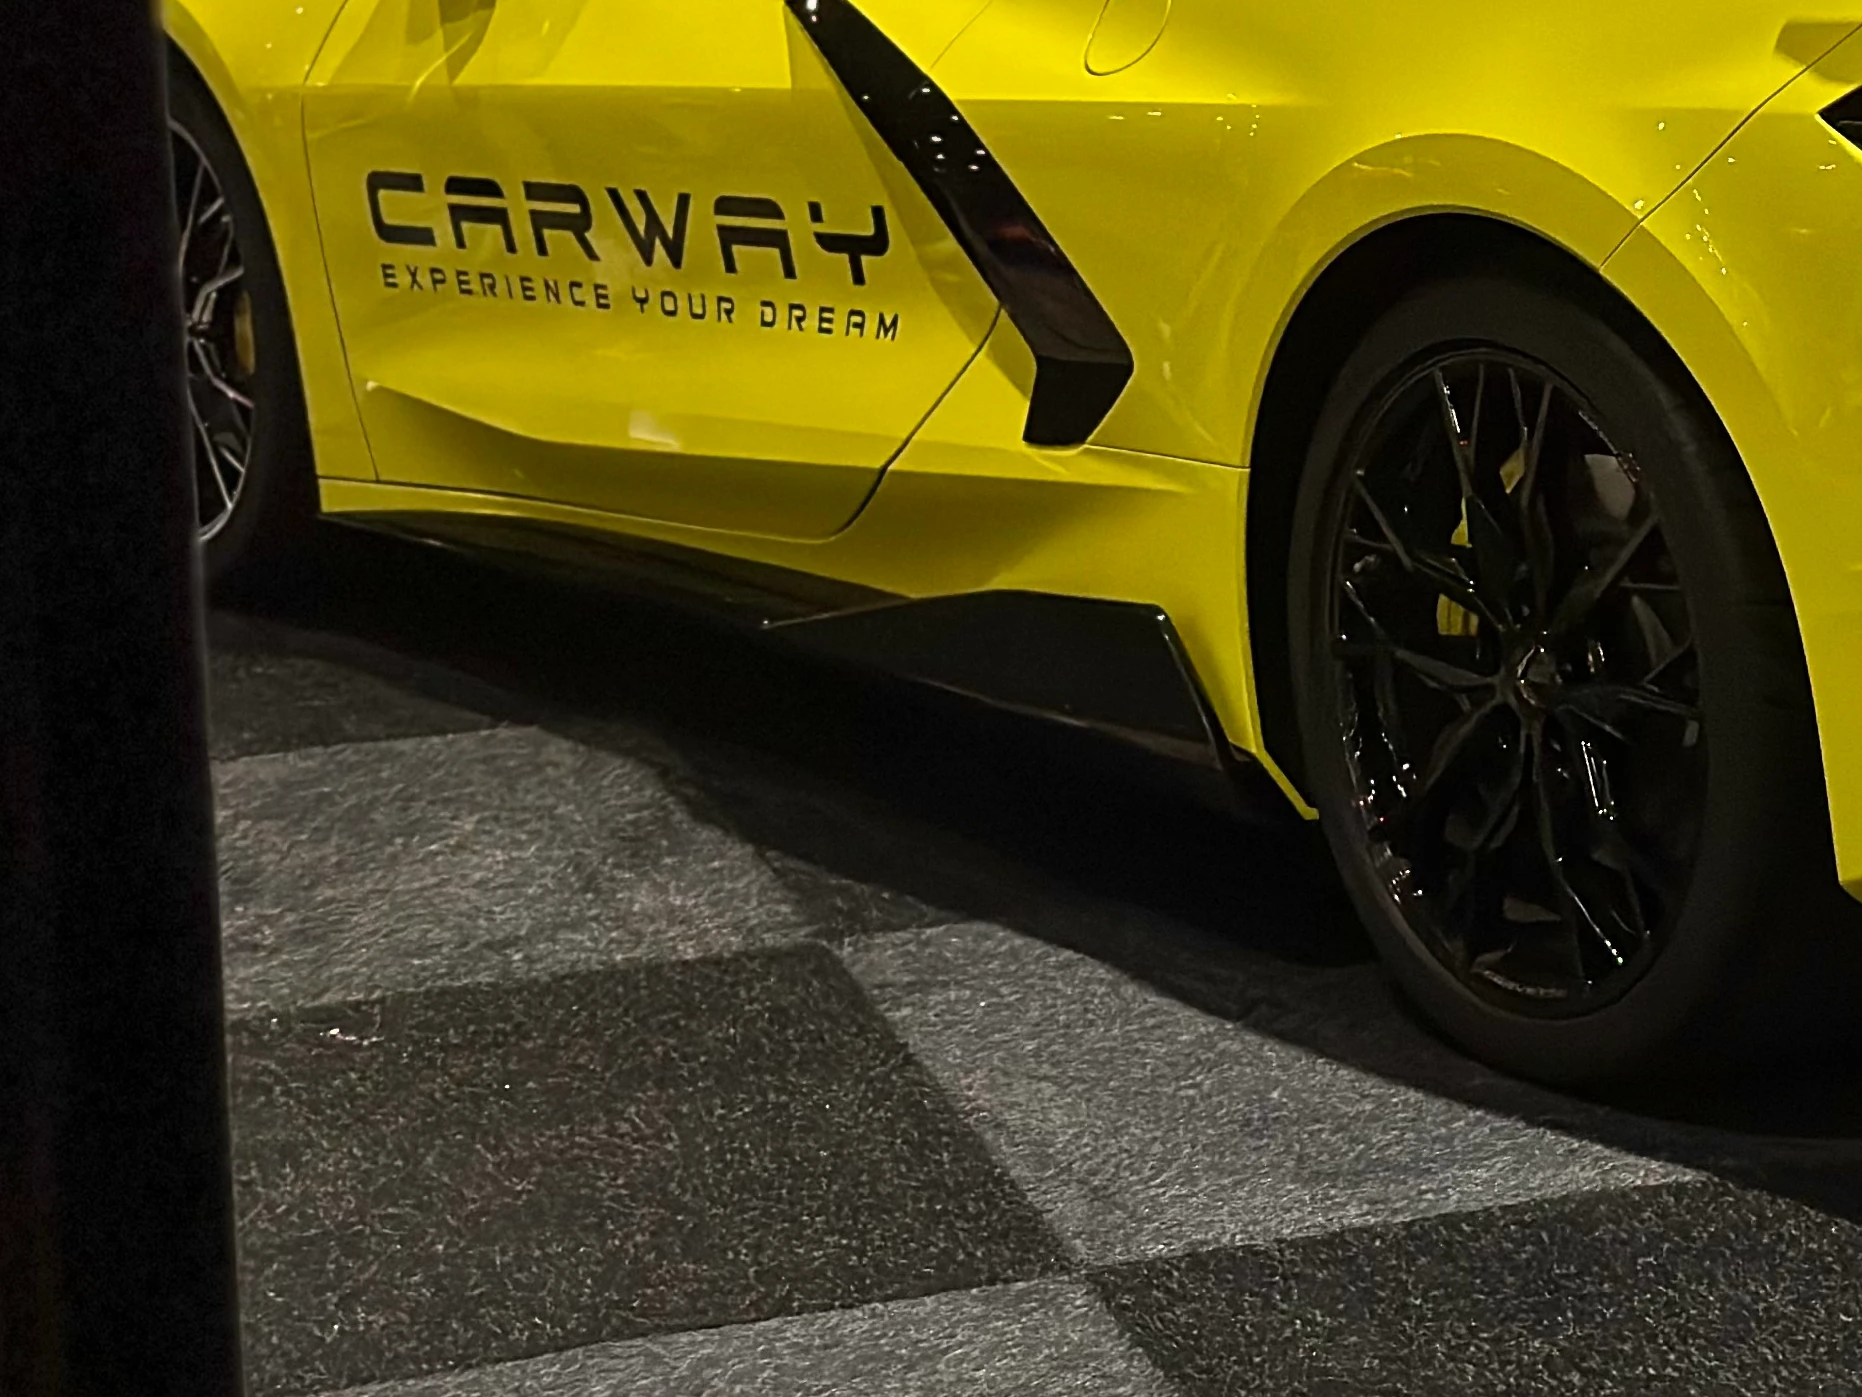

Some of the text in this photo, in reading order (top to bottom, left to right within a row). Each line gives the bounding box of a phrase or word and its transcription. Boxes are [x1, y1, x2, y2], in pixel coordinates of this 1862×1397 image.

[365, 170, 891, 287] CARWAY
[380, 263, 900, 341] EXPERIENCE YOUR DREAM
